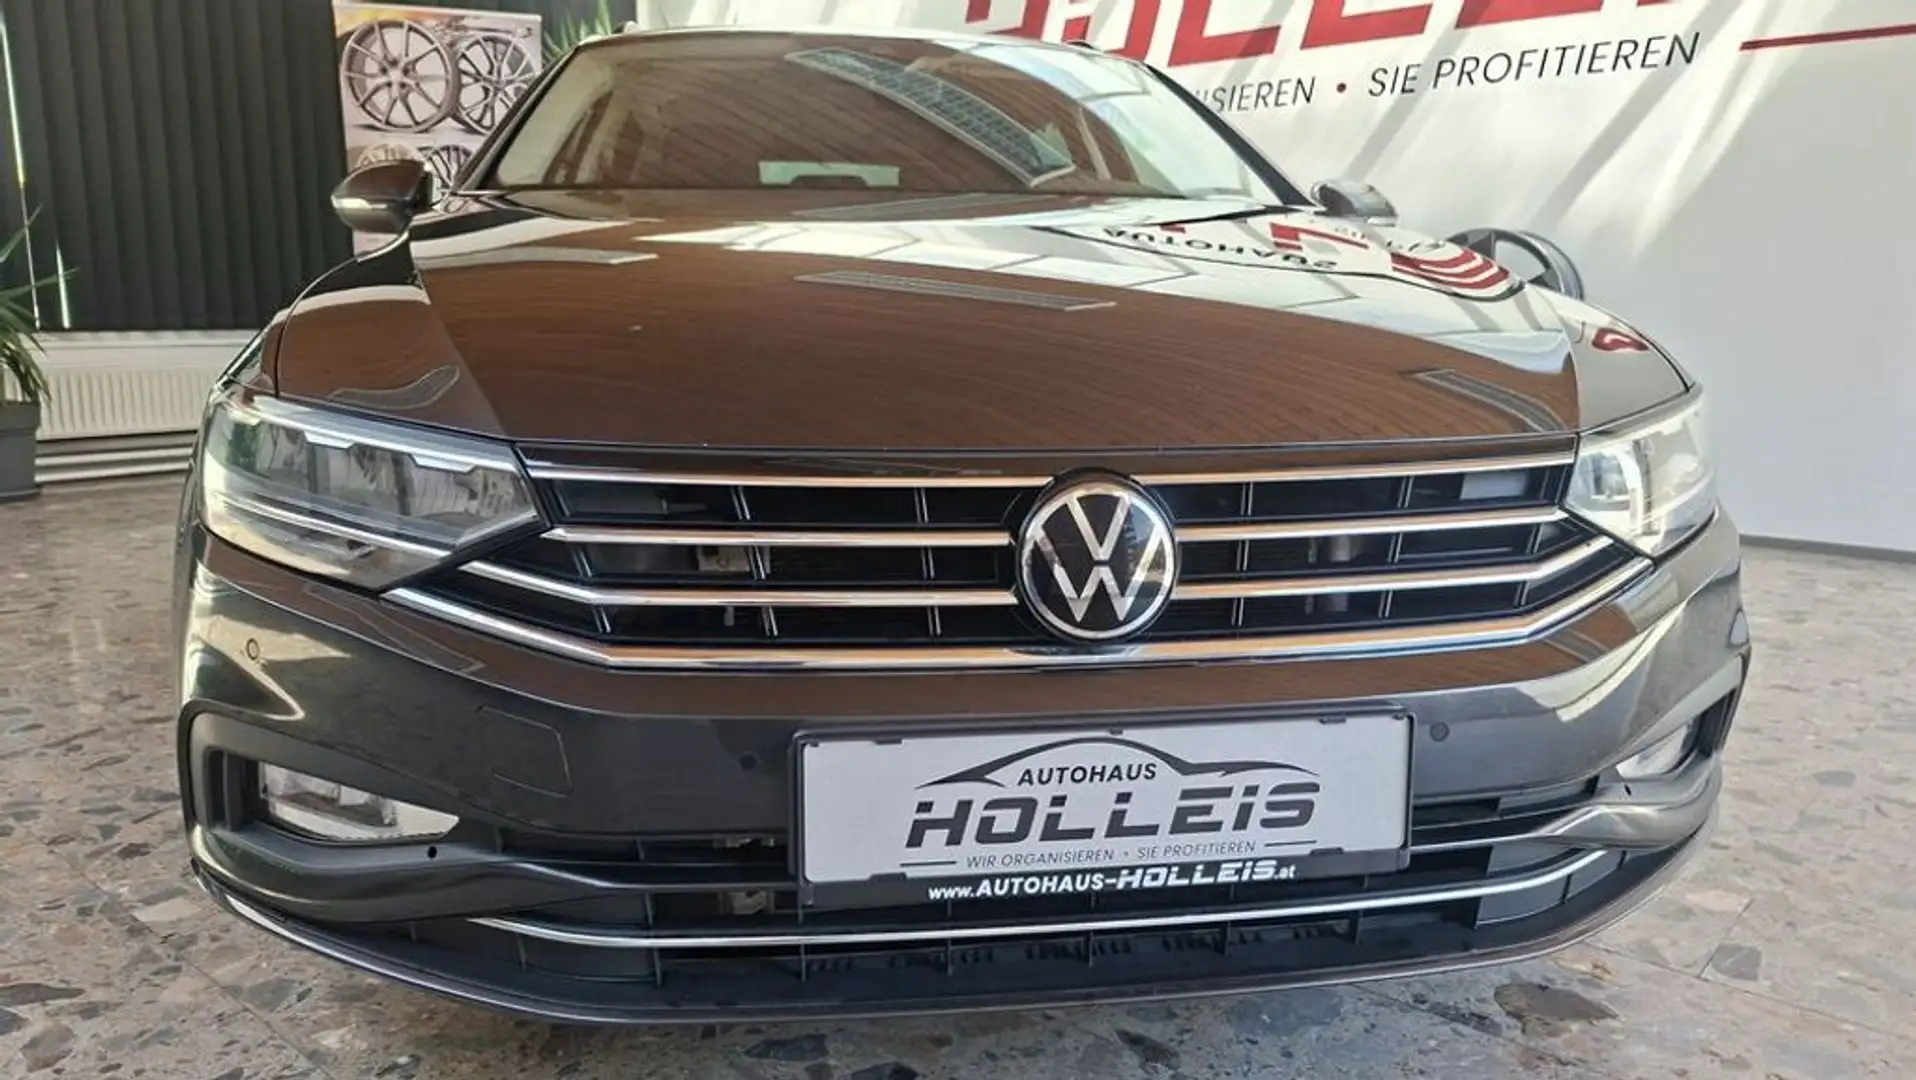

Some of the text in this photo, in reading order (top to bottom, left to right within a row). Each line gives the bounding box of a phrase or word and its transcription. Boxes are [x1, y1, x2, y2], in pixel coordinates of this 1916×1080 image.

[1369, 62, 1421, 97] SIE
[1432, 31, 1701, 90] PROFITIEREN
[1030, 490, 1164, 624] VW
[1017, 762, 1157, 787] AUTOHAUS
[905, 781, 1320, 849] HOLLEIS
[965, 840, 1257, 869] WIR ORGANISIEREN SIE PROFITIEREN
